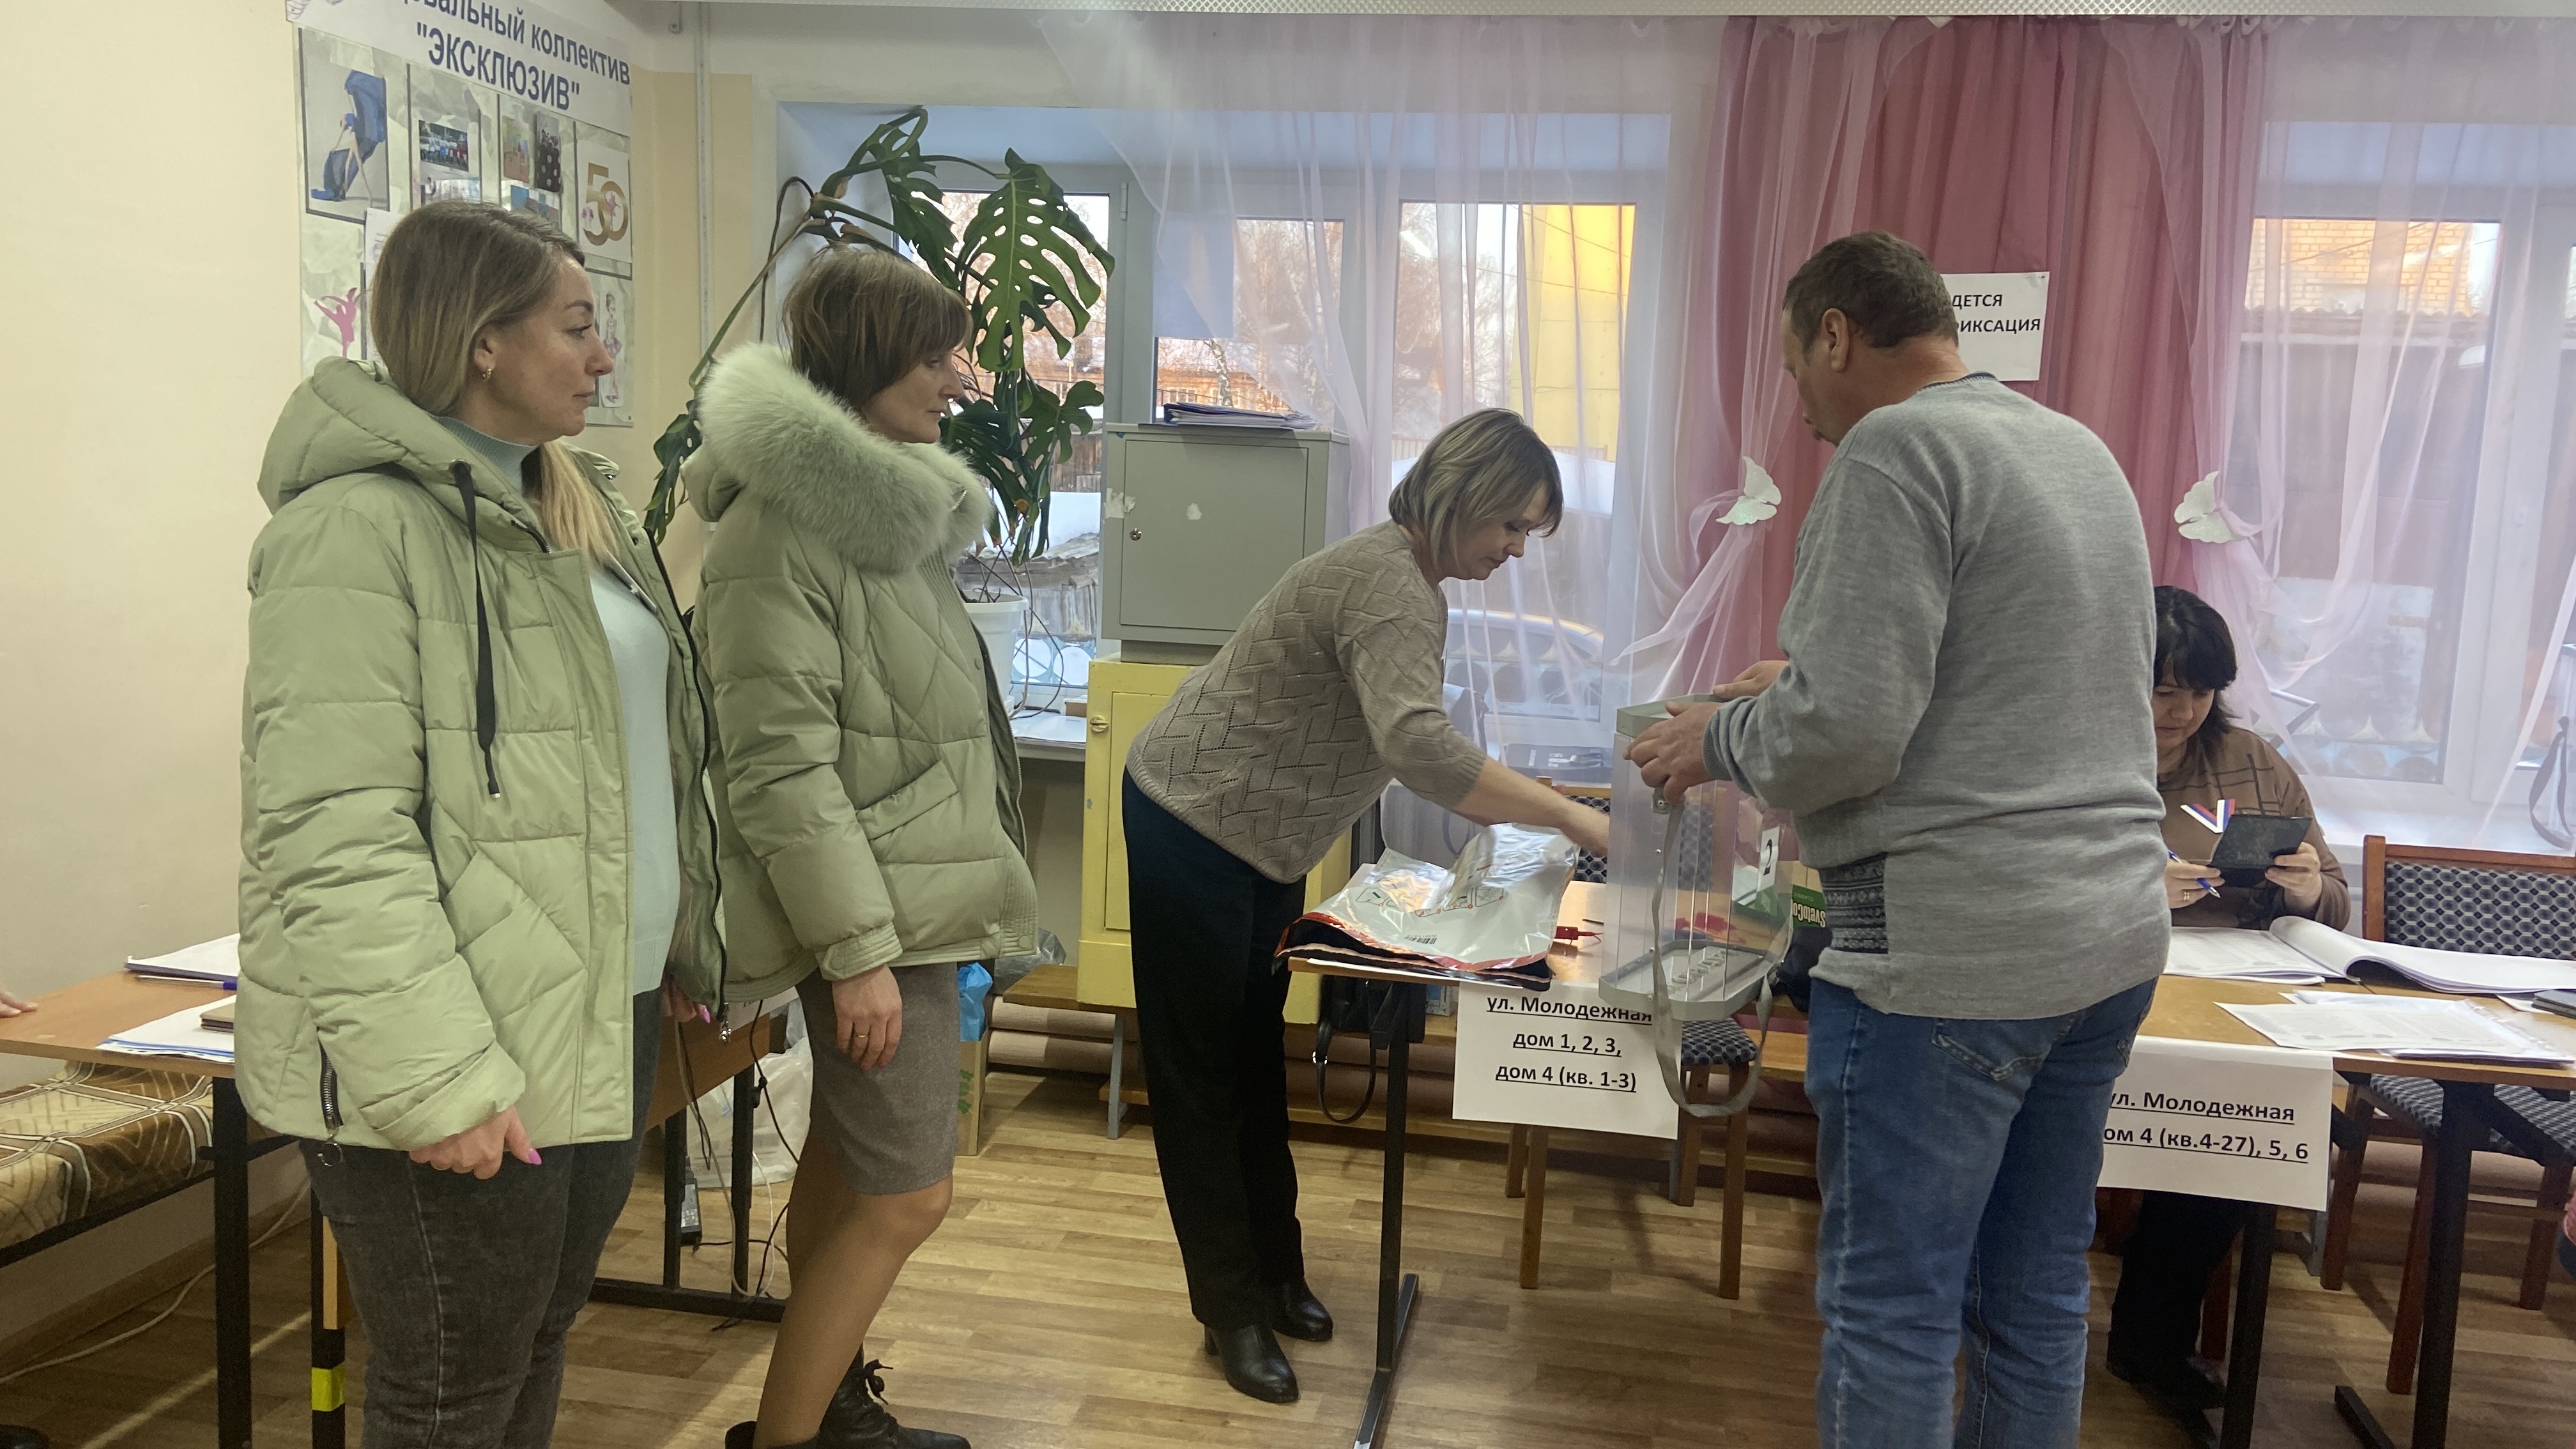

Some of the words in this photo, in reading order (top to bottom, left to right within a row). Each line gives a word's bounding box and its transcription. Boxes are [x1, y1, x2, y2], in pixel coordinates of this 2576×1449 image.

[417, 22, 579, 111] "ЭКСКЛЮЗИВ"
[532, 24, 631, 85] коллектив
[1952, 294, 2002, 309] ДЕТСЯ
[1957, 319, 2041, 335] ИКСАЦИЯ
[1763, 839, 1772, 876] 2
[1792, 902, 1826, 928] SvetoCo
[1486, 997, 1514, 1011] ул.
[1521, 996, 1652, 1022] Молодежная
[1513, 1032, 1554, 1048] дом
[1561, 1034, 1576, 1052] 1,
[1583, 1036, 1598, 1054] 2,
[1605, 1038, 1622, 1057] 3,
[1496, 1066, 1537, 1082] дом
[1542, 1066, 1553, 1081] 4
[1560, 1066, 1593, 1087] (кв.
[1600, 1071, 1637, 1092] 1-3)
[2143, 1092, 2294, 1121] Молодежная
[2103, 1128, 2134, 1142] ом
[2140, 1128, 2152, 1144] 4
[2159, 1128, 2262, 1158] (кв.4-27),
[2269, 1140, 2288, 1160] 5,
[2296, 1143, 2308, 1159] 6
